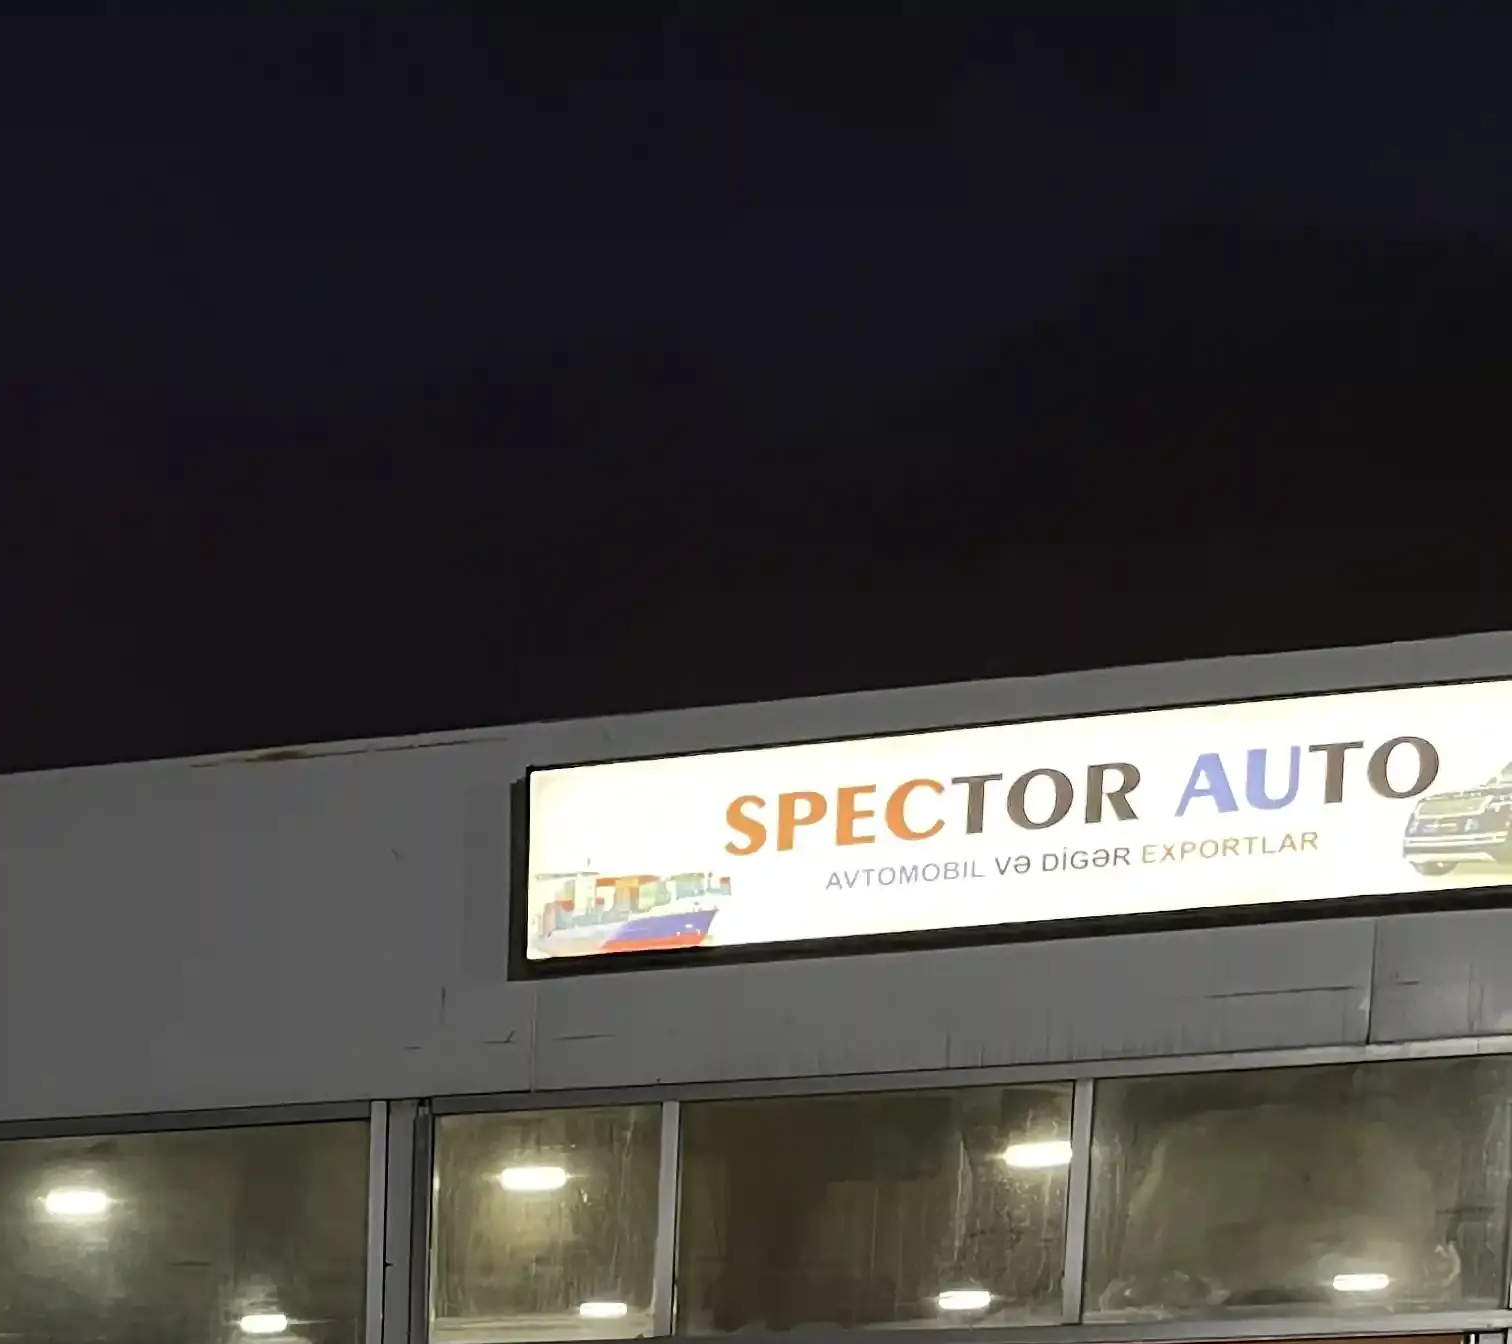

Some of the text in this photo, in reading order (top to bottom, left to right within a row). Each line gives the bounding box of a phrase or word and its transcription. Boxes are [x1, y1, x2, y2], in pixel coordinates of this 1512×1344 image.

[725, 736, 1440, 856] SPECTOR AUTO
[826, 860, 986, 890] AVTOMOBIL
[1142, 832, 1319, 863] EXPORTLAR
